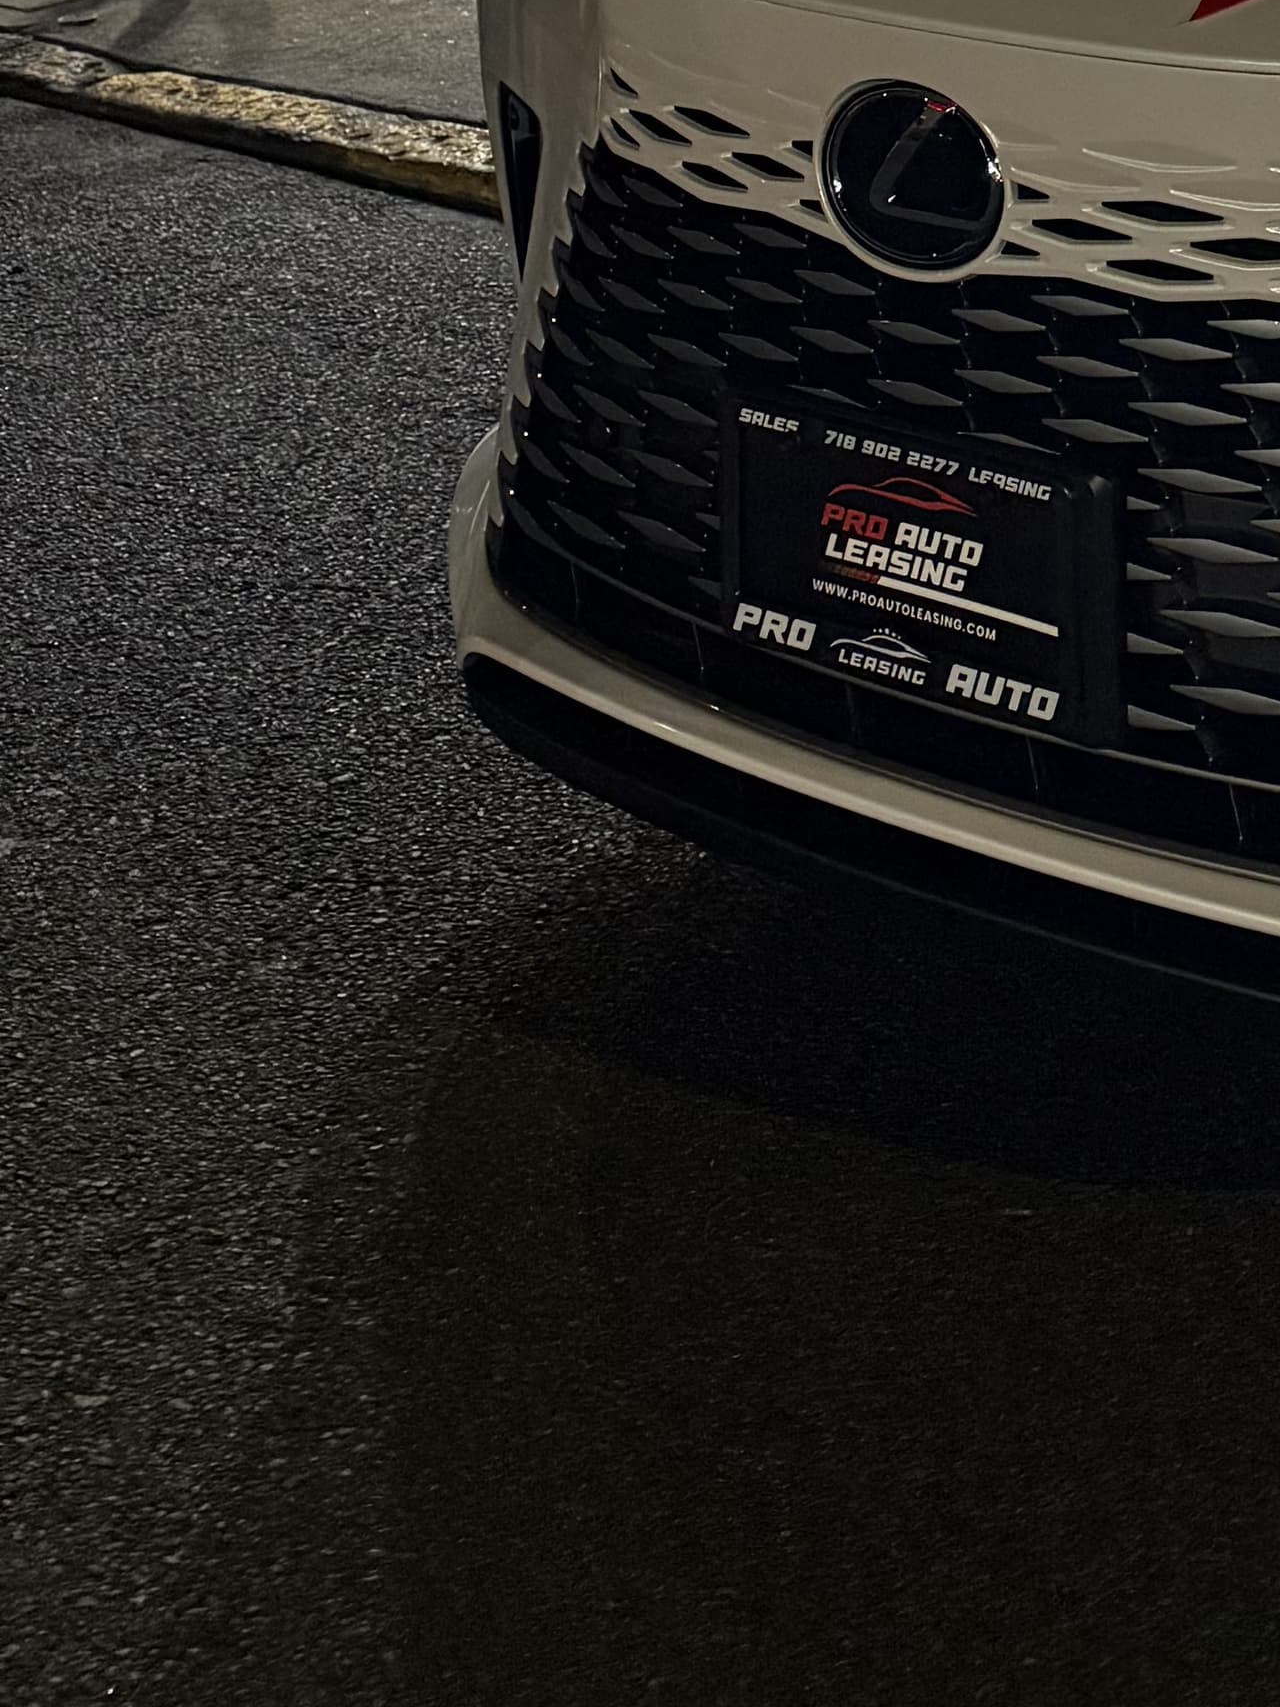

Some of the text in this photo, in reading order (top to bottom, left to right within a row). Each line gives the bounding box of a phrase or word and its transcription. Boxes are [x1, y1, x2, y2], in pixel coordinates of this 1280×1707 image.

[824, 430, 857, 450] 718
[861, 440, 901, 461] 902
[906, 451, 960, 475] 2277
[821, 502, 984, 567] PRO AUTO
[824, 533, 966, 592] LEASING
[812, 578, 996, 641] WWW.PROAUTOLEASING.COM
[732, 602, 1060, 721] PRO LEASING AUTO
